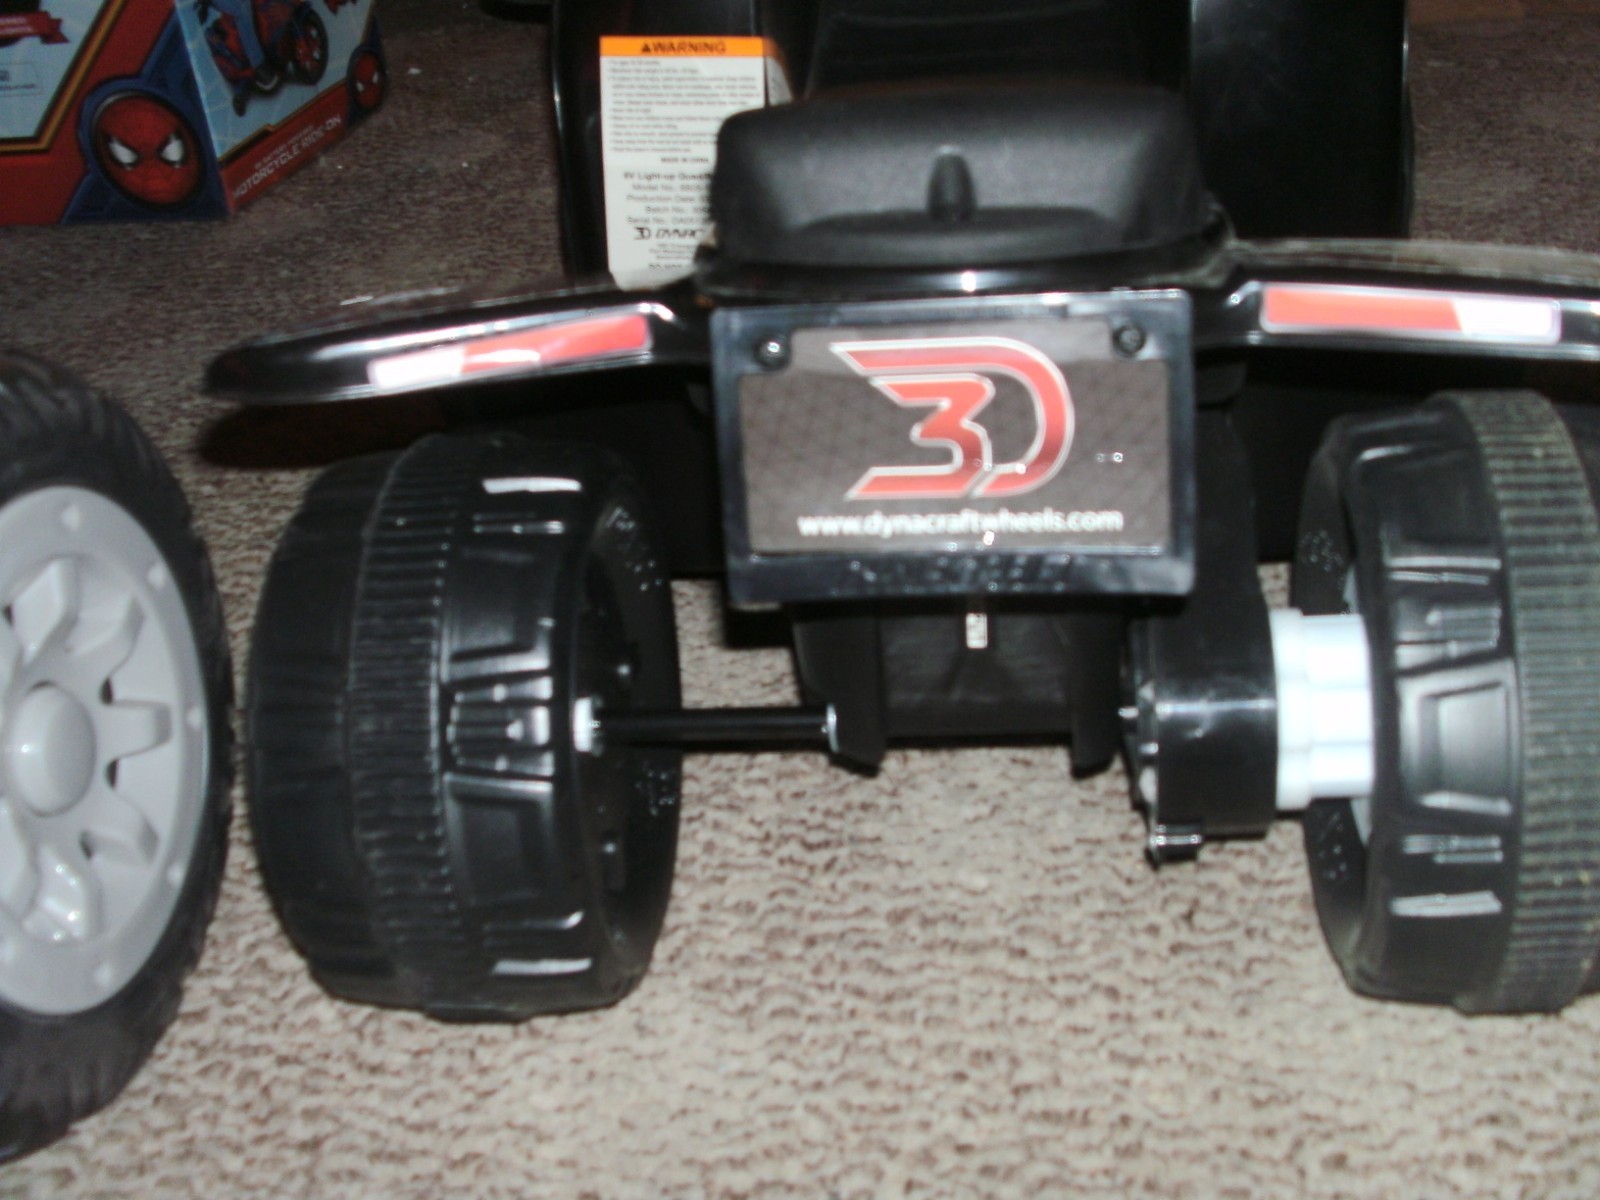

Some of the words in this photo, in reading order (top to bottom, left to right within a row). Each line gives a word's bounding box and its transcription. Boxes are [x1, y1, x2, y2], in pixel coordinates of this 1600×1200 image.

[653, 42, 727, 54] WARNING
[232, 144, 302, 199] MOTORCYCLE
[302, 114, 342, 149] RIDE-ON
[638, 172, 675, 182] Light-up
[829, 336, 1076, 501] 3D
[797, 508, 1124, 538] www.dynacraftwheels.com
